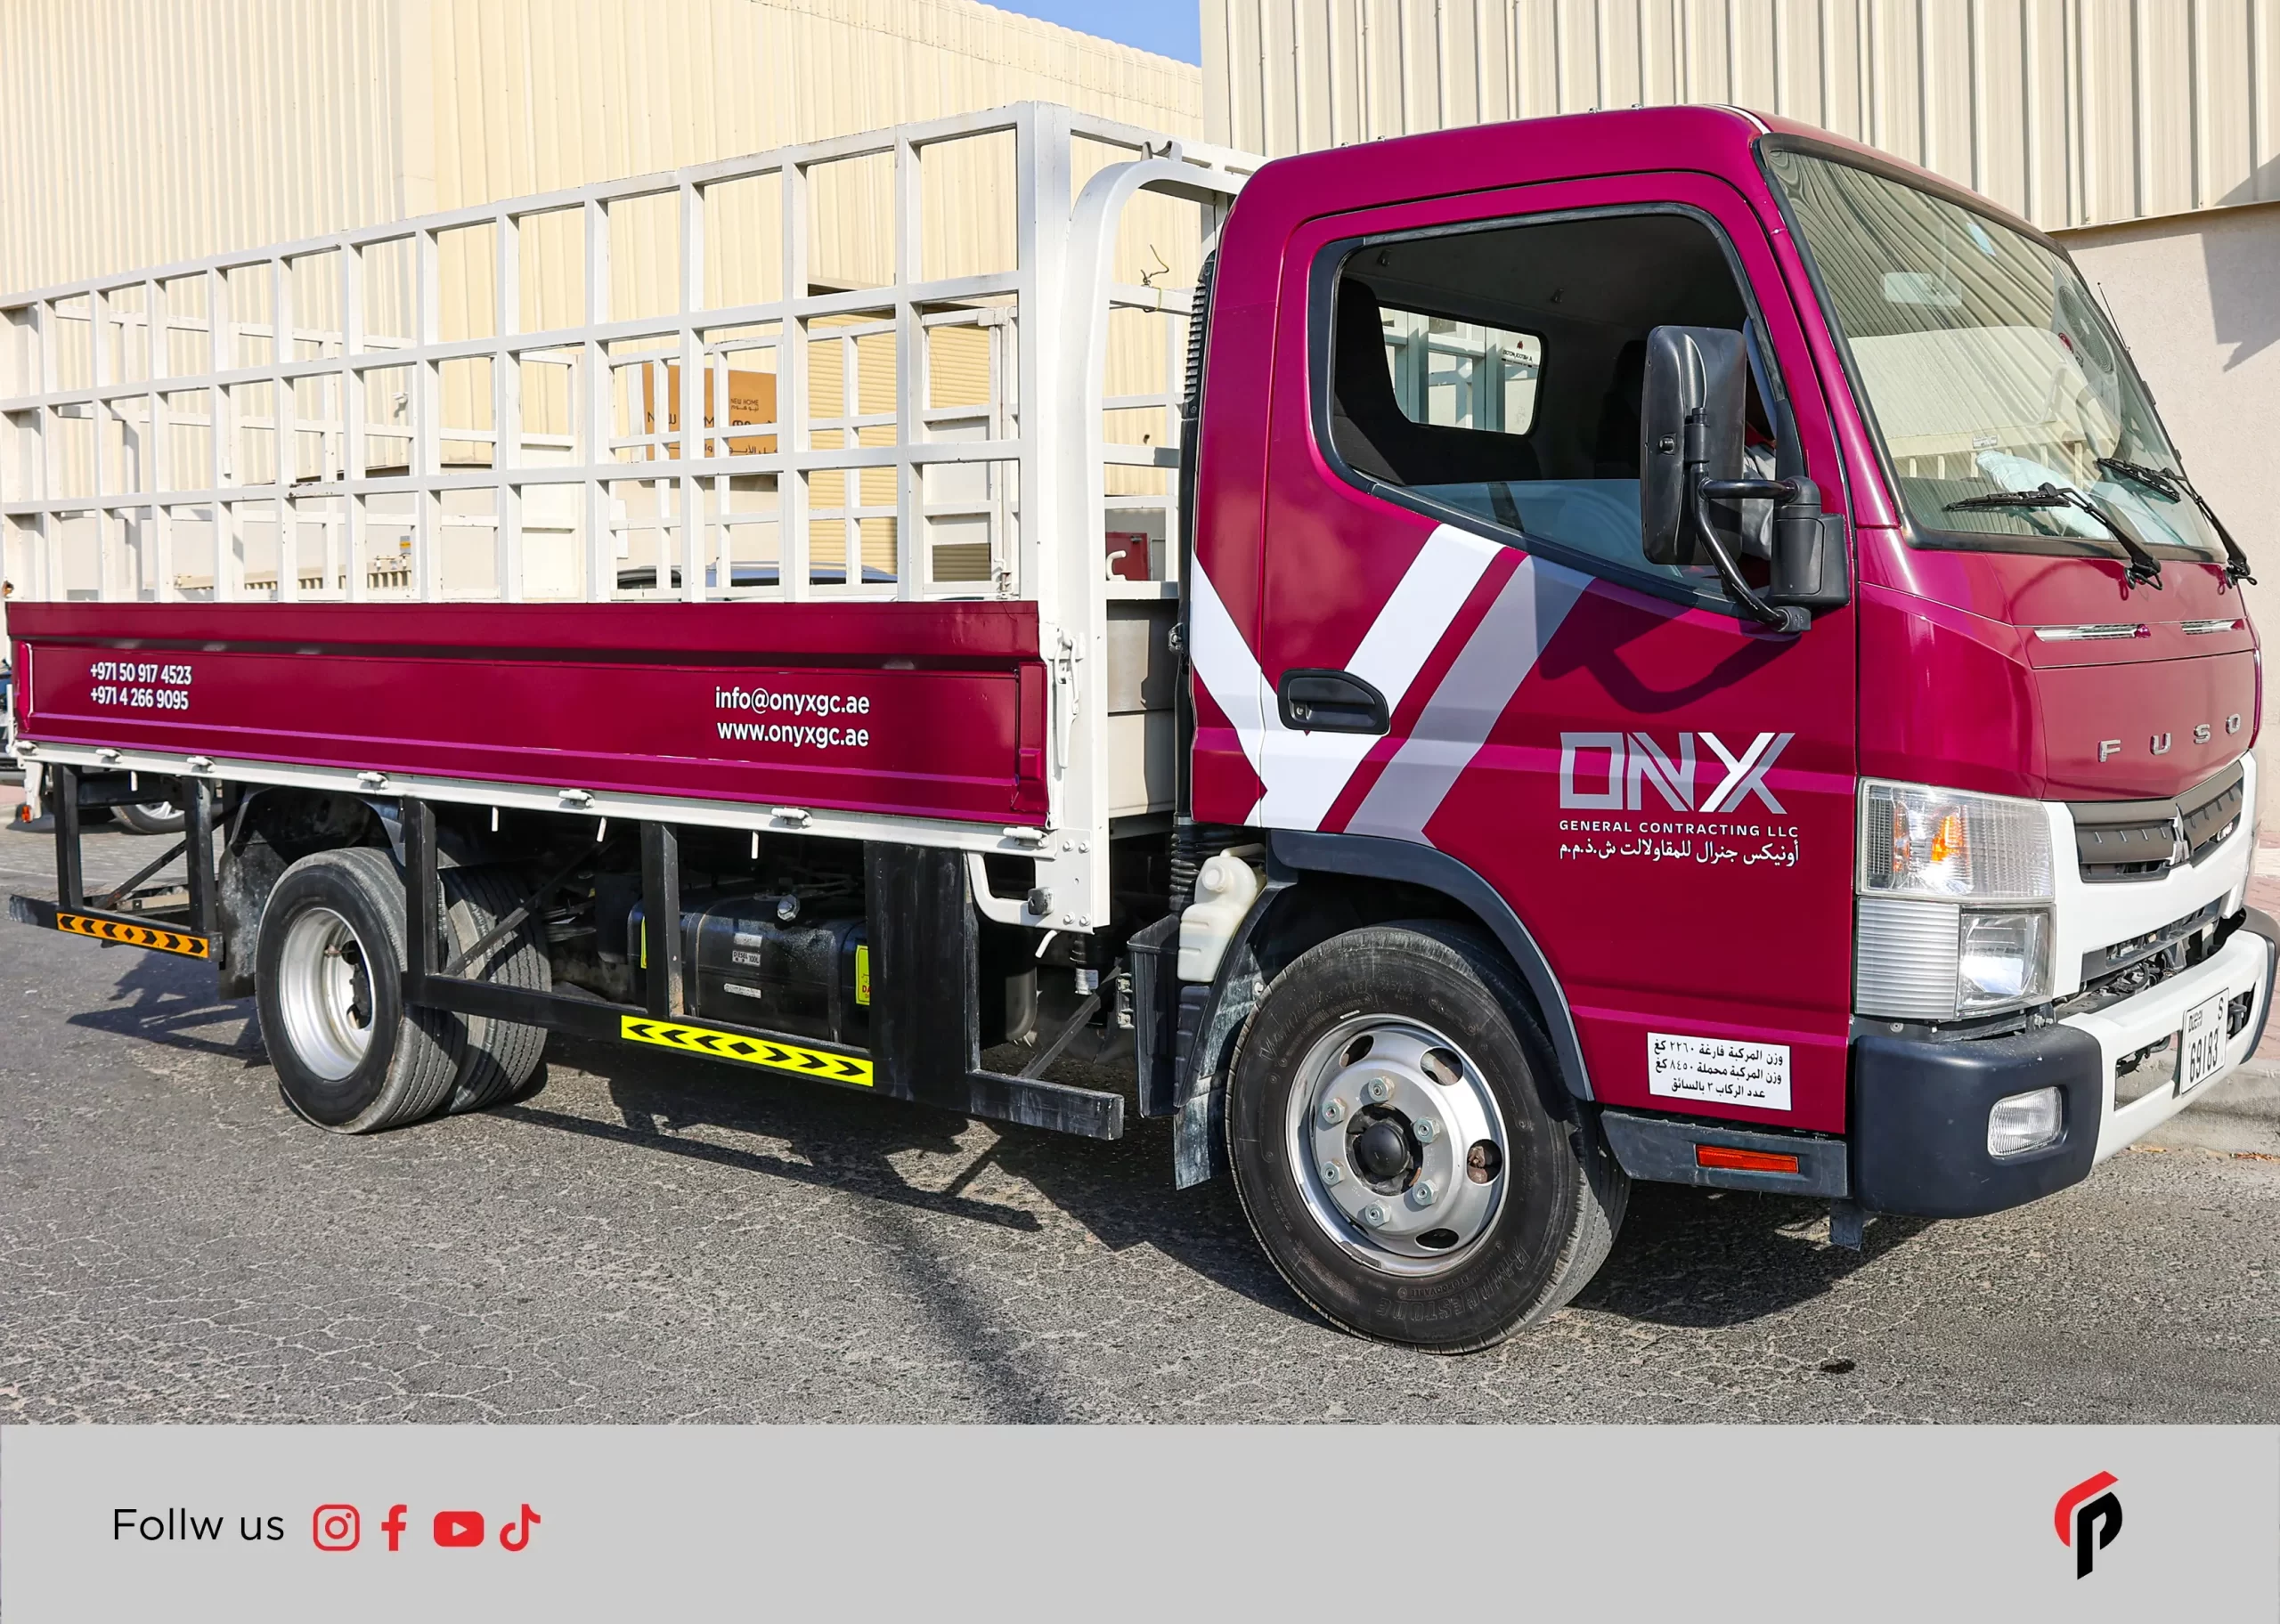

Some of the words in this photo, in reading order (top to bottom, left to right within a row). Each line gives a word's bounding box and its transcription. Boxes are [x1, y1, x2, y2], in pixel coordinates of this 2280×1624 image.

[90, 662, 117, 681] +971
[119, 662, 135, 682] 50
[137, 663, 159, 683] 917
[160, 665, 192, 685] 4523
[90, 686, 117, 704] +971
[119, 687, 128, 705] 4
[130, 687, 153, 707] 266
[156, 689, 189, 710] 9095
[715, 686, 870, 717] info@onyxgc.ae
[717, 722, 869, 749] www.onyxgc.ae
[2098, 713, 2241, 763] FUSO
[1559, 820, 1633, 832] GENERAL
[1639, 822, 1760, 836] CONTRACTING
[1768, 826, 1799, 838] LLC
[1696, 840, 1738, 865] جنرال
[1743, 839, 1799, 867] أونيكس
[2218, 996, 2224, 1020] S
[1698, 1043, 1724, 1060] فارغة
[1729, 1046, 1763, 1063] المركبة
[1766, 1054, 1783, 1066] وزن
[2190, 1027, 2219, 1084] 69183
[1697, 1061, 1728, 1076] محملة
[1730, 1064, 1763, 1081] المركبة
[1672, 1077, 1705, 1095] بالسائق
[1765, 1072, 1782, 1084] وزن
[1715, 1083, 1744, 1099] الركاب
[1747, 1089, 1766, 1098] عدد
